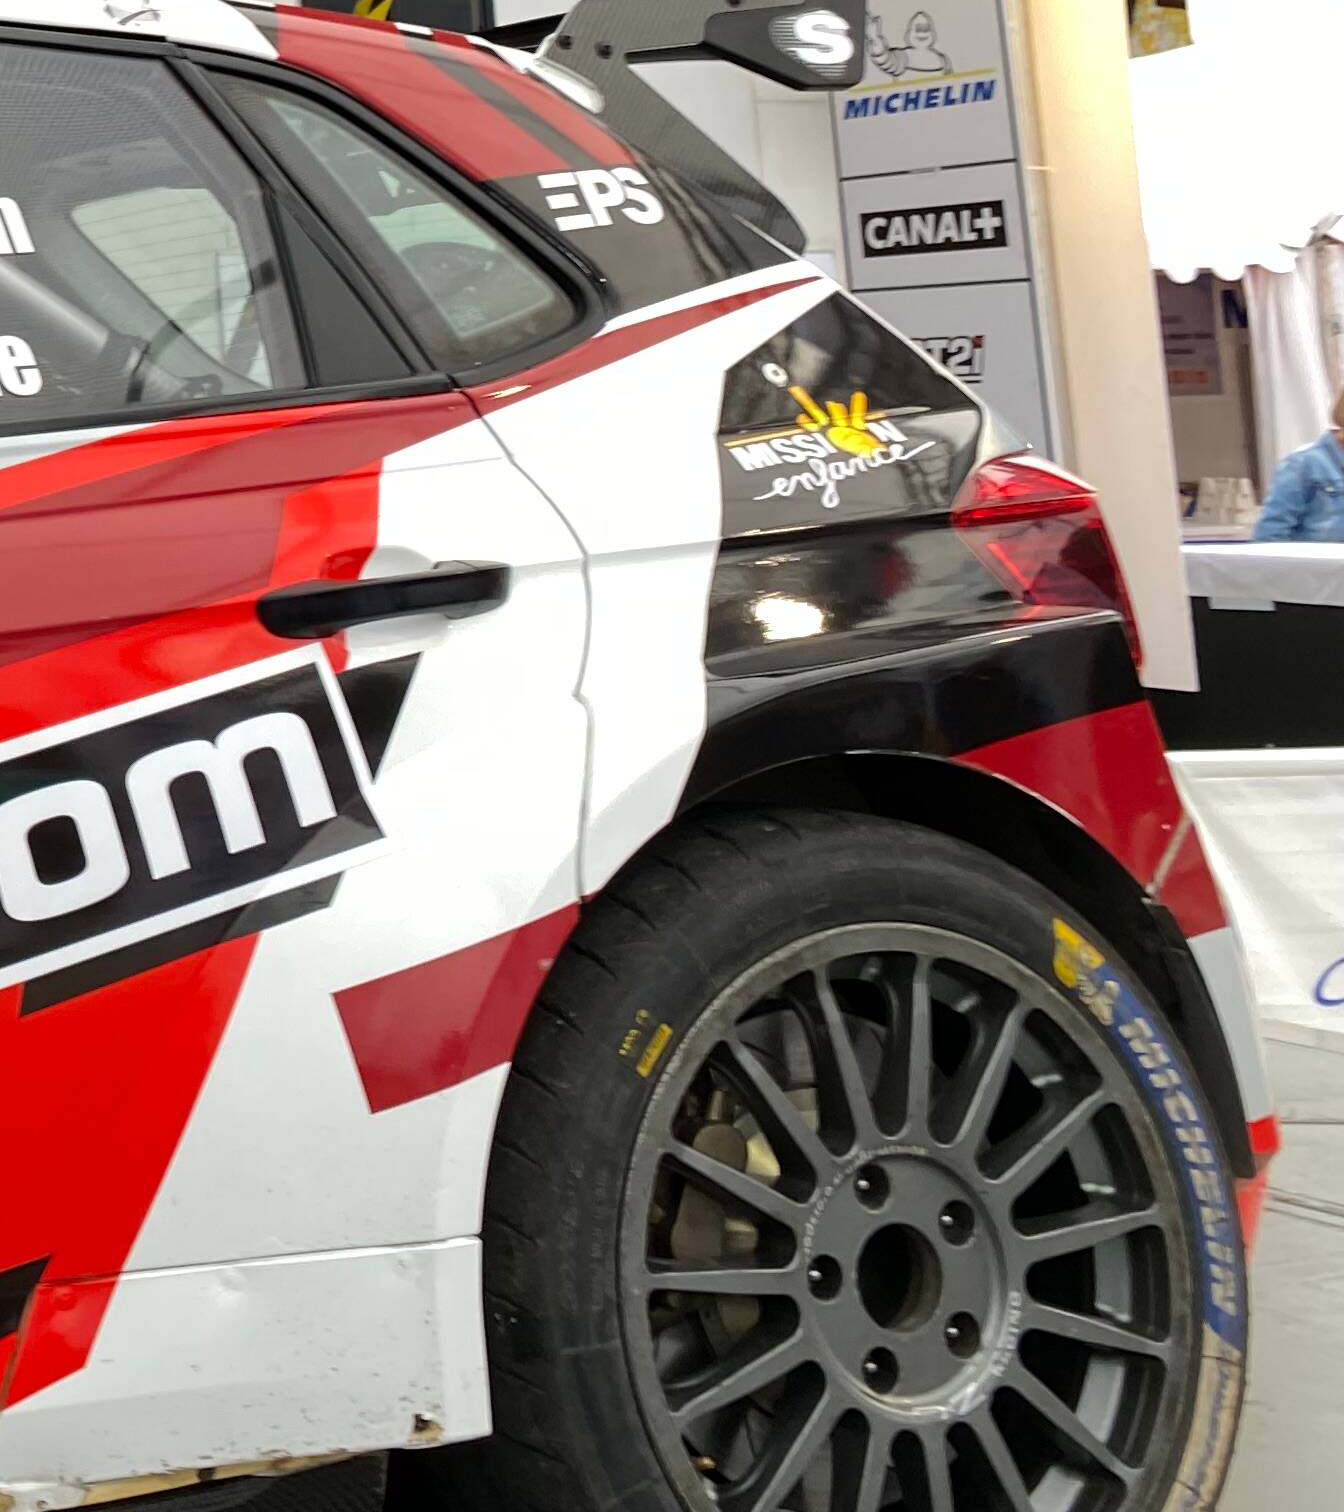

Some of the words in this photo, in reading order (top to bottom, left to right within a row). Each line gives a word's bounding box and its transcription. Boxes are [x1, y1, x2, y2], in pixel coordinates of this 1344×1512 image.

[843, 80, 998, 120] MICHELIN
[537, 167, 664, 232] EPS
[864, 206, 1002, 250] CANAL+
[1119, 1017, 1238, 1317] MICHELIN
